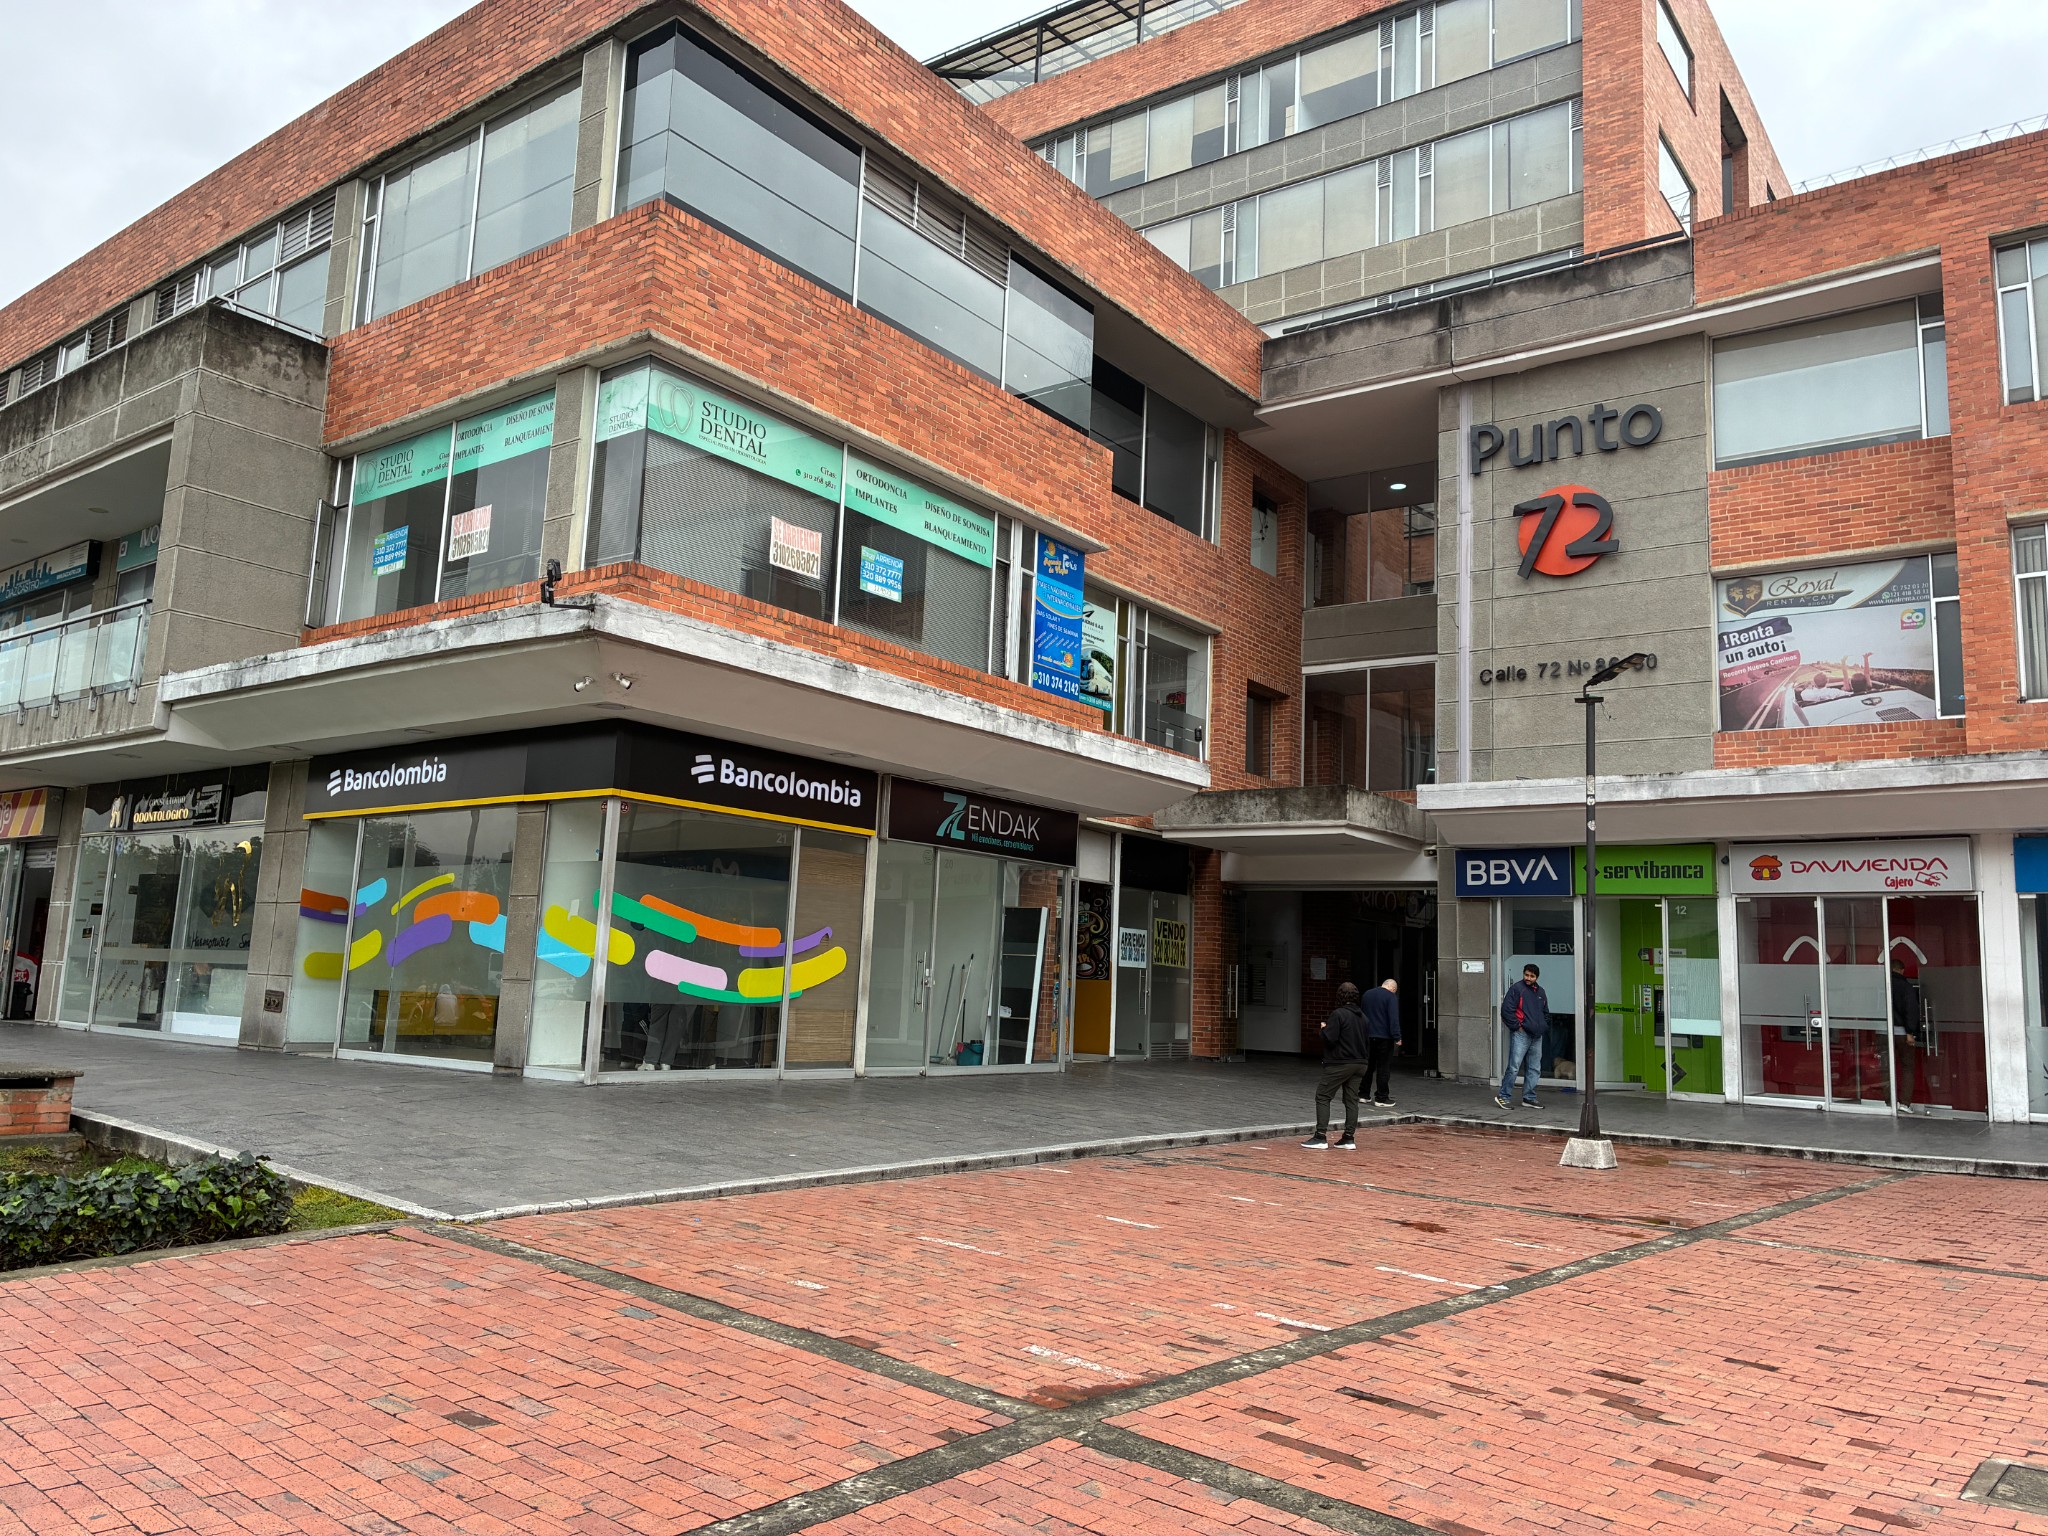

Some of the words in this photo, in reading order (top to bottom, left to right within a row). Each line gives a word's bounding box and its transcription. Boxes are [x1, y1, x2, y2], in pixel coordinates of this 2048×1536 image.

[506, 410, 527, 426] DISEÑO
[528, 409, 537, 418] DE
[537, 402, 554, 415] SONR
[609, 410, 633, 424] STUDIO
[702, 401, 767, 439] STUDIO
[456, 423, 493, 442] ORTODONCIA
[504, 423, 553, 447] BLANQUEAMIENT
[608, 420, 633, 433] DENTAL
[700, 417, 767, 458] DENTAL
[1470, 403, 1662, 476] Punto
[380, 449, 414, 470] STUDIO
[455, 444, 485, 460] IMPLANTES
[378, 462, 413, 483] DENTAL
[803, 471, 813, 480] 310
[813, 475, 824, 484] 268
[856, 469, 908, 499] ORTODONCIA
[855, 488, 898, 514] IMPLANTES
[925, 500, 951, 520] DISEÑO
[952, 511, 962, 524] DE
[962, 514, 991, 538] SONRISA
[774, 518, 783, 542] SE
[782, 520, 822, 552] ARRIENDA
[924, 520, 987, 555] BLANQUEAMIENTO
[1512, 492, 1619, 580] 72
[772, 541, 819, 576] 3102685821
[864, 560, 875, 572] 310
[875, 564, 886, 576] 372
[887, 569, 902, 580] 7777
[875, 553, 903, 568] ARRIENDA
[862, 569, 874, 580] 320
[875, 573, 886, 584] 889
[886, 578, 902, 590] 9956
[1768, 571, 1838, 597] Royal
[1766, 598, 1794, 607] RENT
[1812, 593, 1835, 602] CAR
[1723, 625, 1774, 648] !Renta
[1725, 651, 1744, 664] un
[1747, 640, 1787, 658] auto¡
[1479, 665, 1527, 685] Calle
[1537, 661, 1561, 678] 72
[1722, 668, 1747, 679] Recorre
[1747, 661, 1769, 672] Nuevos
[1770, 654, 1797, 666] Caminos
[1038, 671, 1050, 687] 310
[1051, 675, 1063, 691] 374
[1063, 680, 1079, 696] 2142
[344, 756, 447, 792] Bancolombia
[720, 758, 861, 808] Bancolombia
[133, 808, 189, 824] ODONTOLOGICO
[936, 791, 1041, 841] ZENDAK
[776, 832, 787, 844] 21
[1466, 855, 1559, 886] BBVA
[1603, 861, 1704, 880] servibanca
[1790, 857, 1948, 874] DAVIVIENDA
[1884, 876, 1913, 889] Cajero
[1675, 905, 1687, 915] 12
[1156, 920, 1186, 941] VENDO
[1550, 943, 1575, 953] BBV
